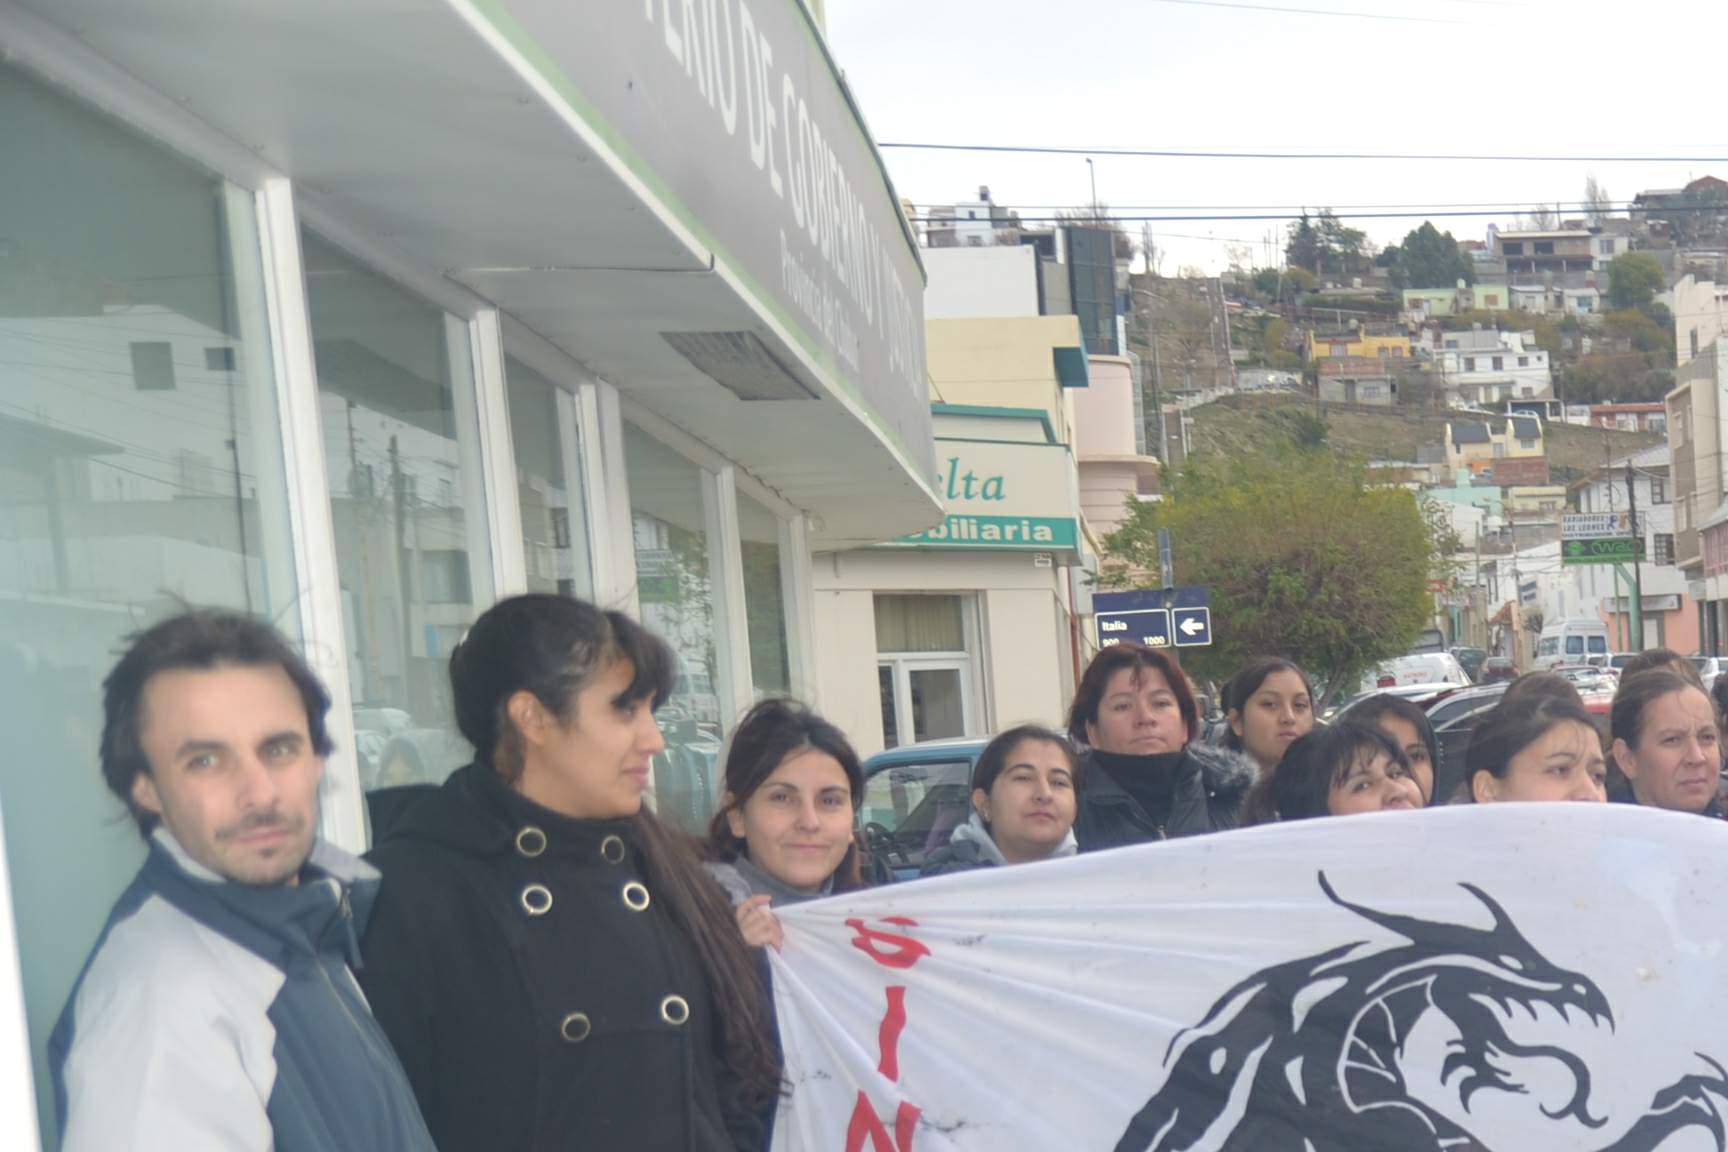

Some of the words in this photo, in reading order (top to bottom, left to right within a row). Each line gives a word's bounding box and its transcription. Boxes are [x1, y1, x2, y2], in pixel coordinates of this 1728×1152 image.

[740, 2, 784, 199] DE
[783, 73, 873, 326] GOBIERNO
[937, 456, 1007, 502] lta
[1101, 620, 1128, 632] Italia
[1143, 635, 1166, 646] 1000
